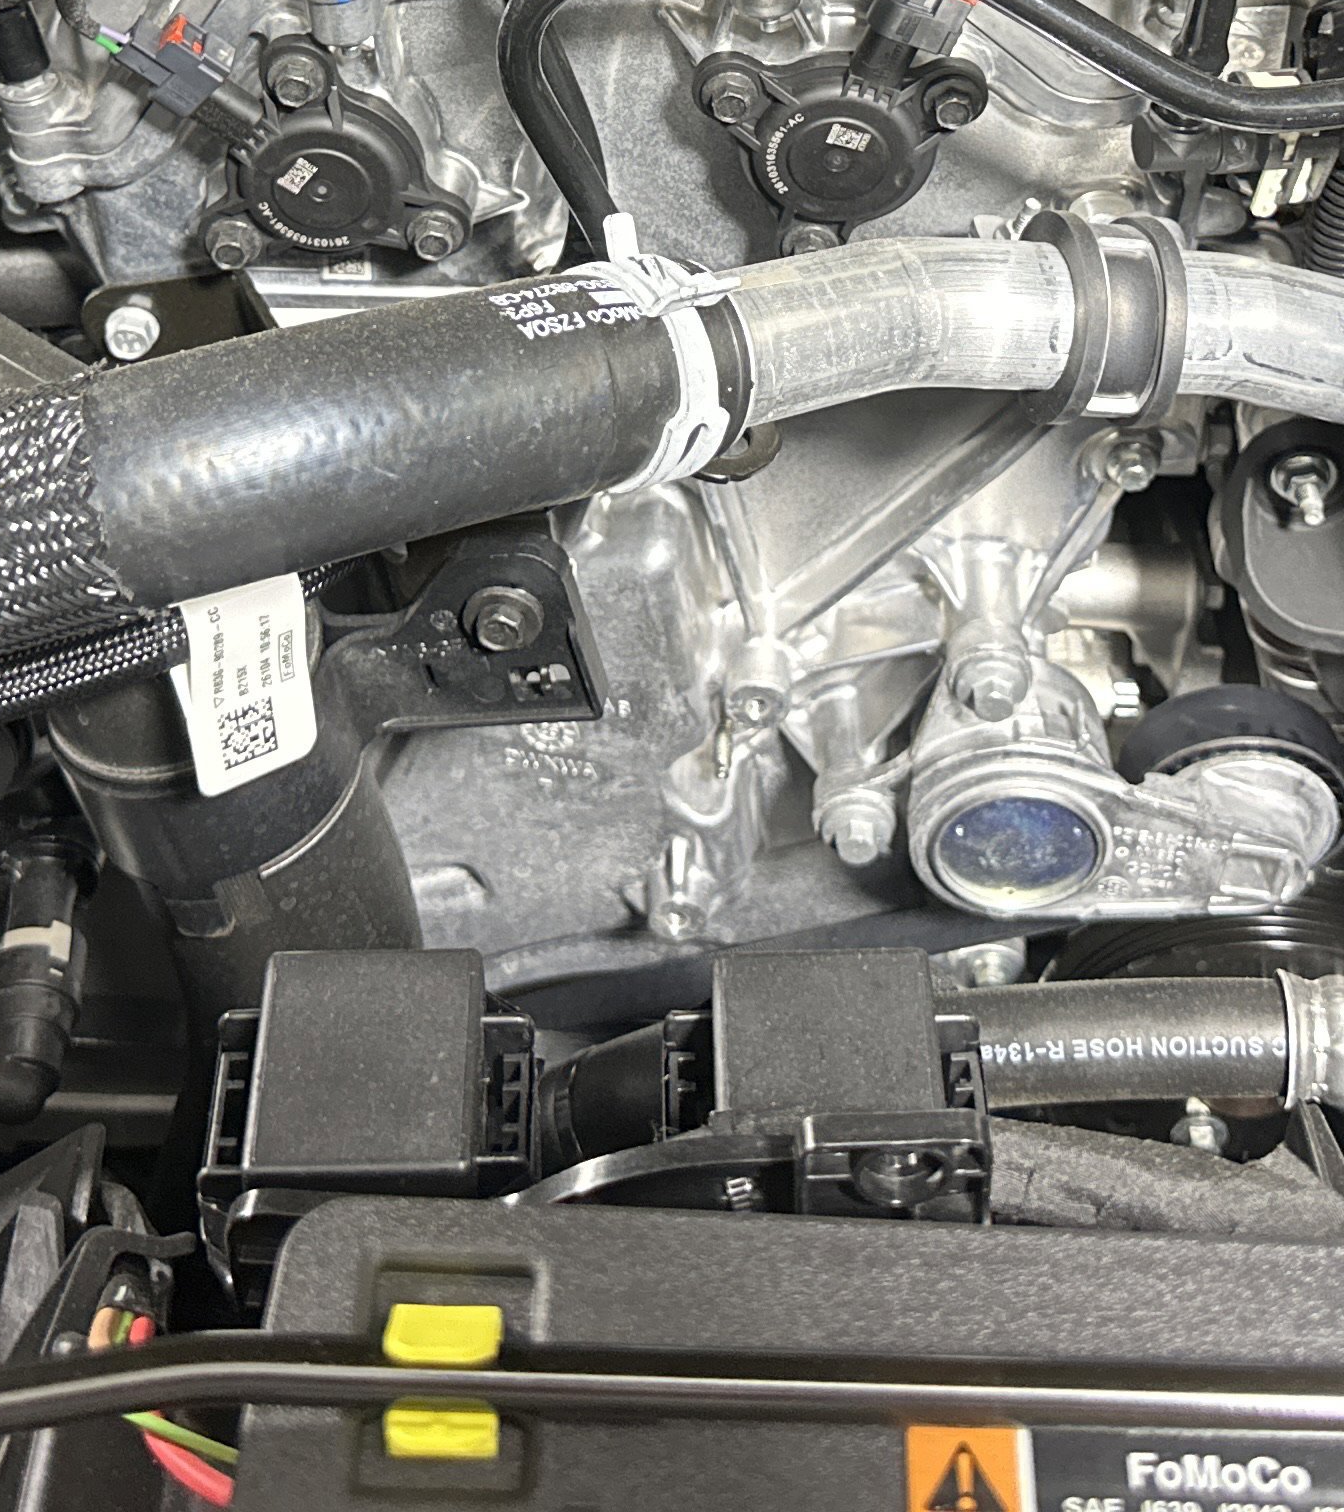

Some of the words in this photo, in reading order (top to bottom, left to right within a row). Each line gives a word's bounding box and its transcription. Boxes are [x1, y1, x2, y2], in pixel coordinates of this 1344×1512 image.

[586, 305, 644, 325] oMoCo
[281, 634, 292, 677] FoMoCo
[981, 1039, 1065, 1064] R-134a
[1072, 1036, 1144, 1060] HOSE
[1150, 1035, 1264, 1057] SUCTION
[1125, 1451, 1312, 1492] FoMoCo
